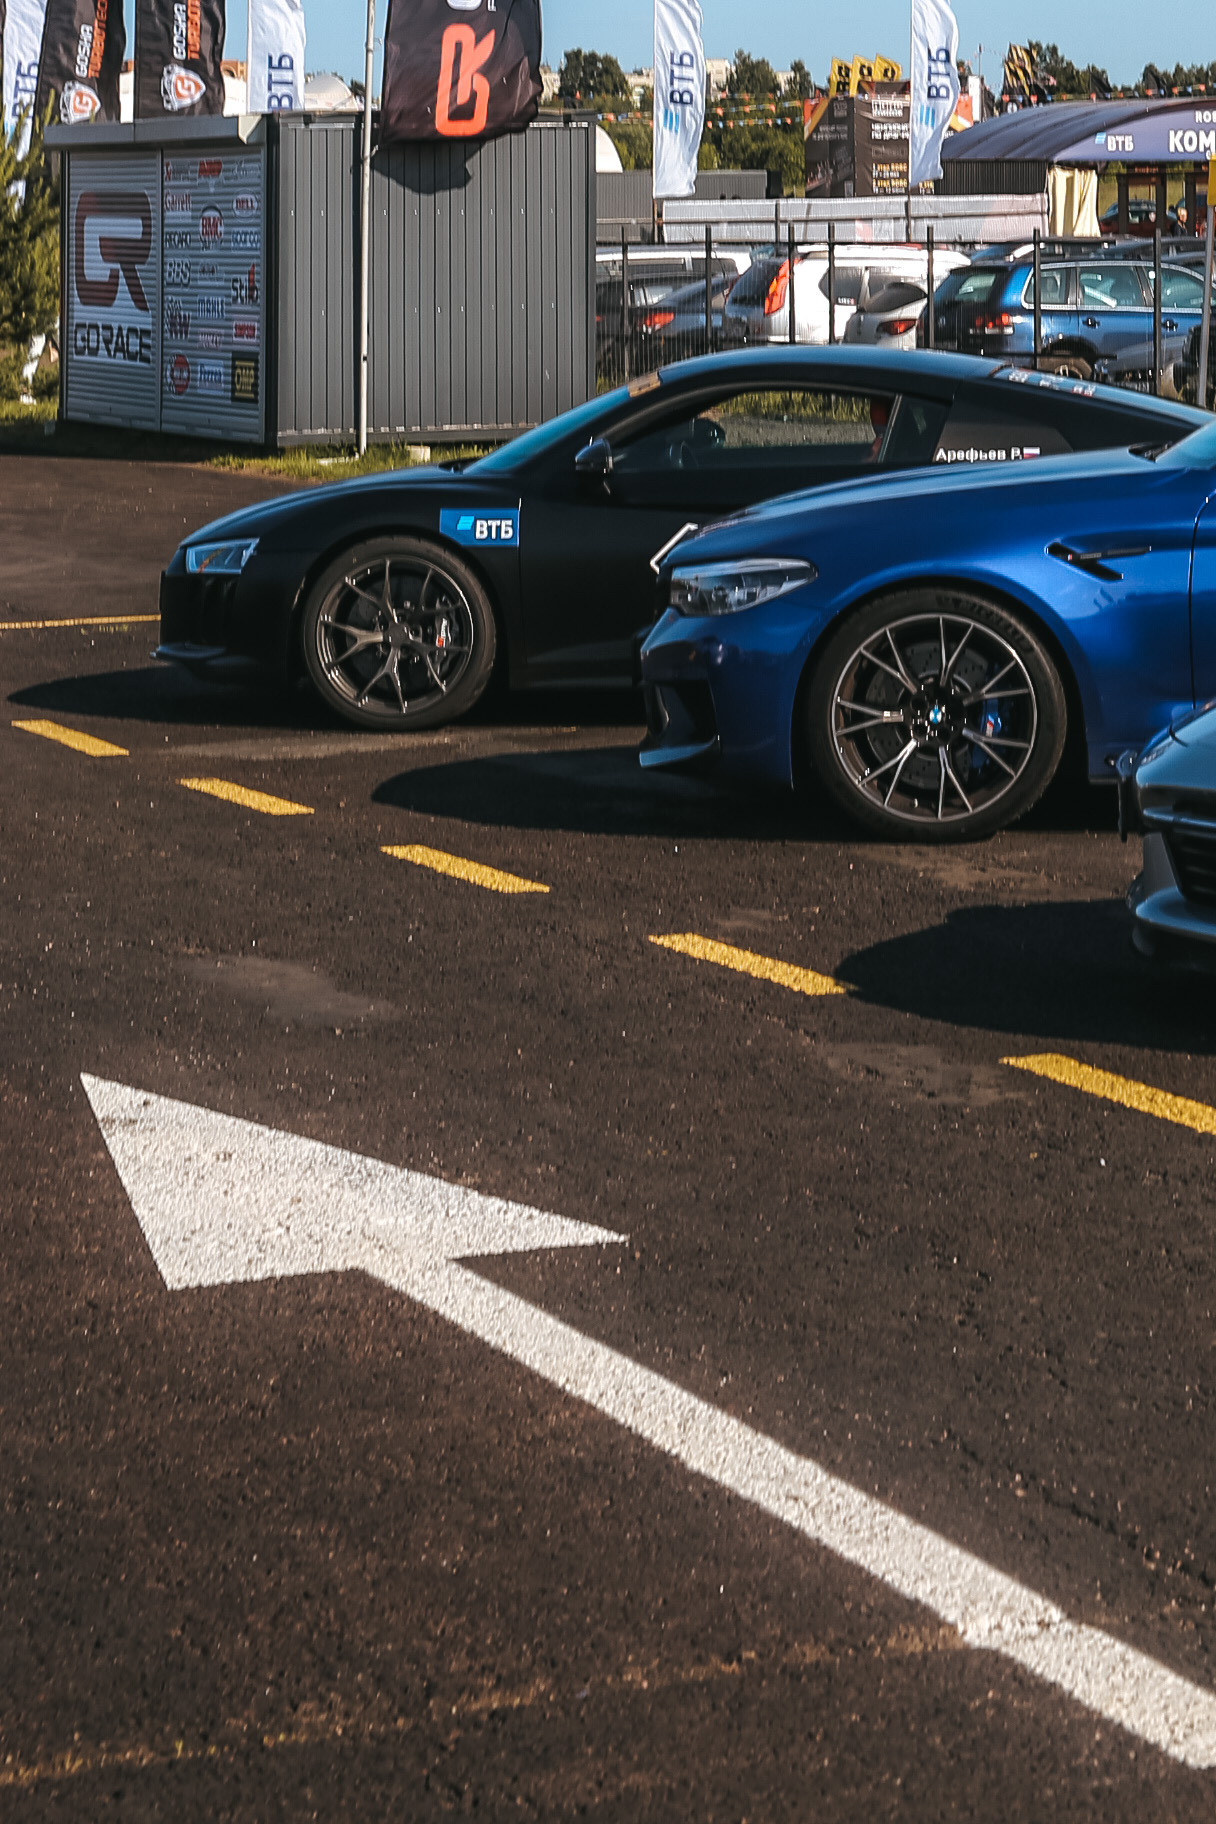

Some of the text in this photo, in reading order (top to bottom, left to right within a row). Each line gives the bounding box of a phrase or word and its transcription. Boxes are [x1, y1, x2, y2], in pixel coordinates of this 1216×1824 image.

[75, 24, 94, 77] GOSHA
[172, 3, 187, 59] GOSHA
[267, 53, 294, 111] ВТБ
[670, 49, 695, 106] ВТБ
[927, 46, 951, 101] ВТБ
[1107, 135, 1134, 151] ВТБ
[165, 259, 191, 288] BBS
[73, 321, 152, 364] GORACE
[935, 447, 1006, 463] Арефьев
[475, 519, 514, 539] ВТБ
